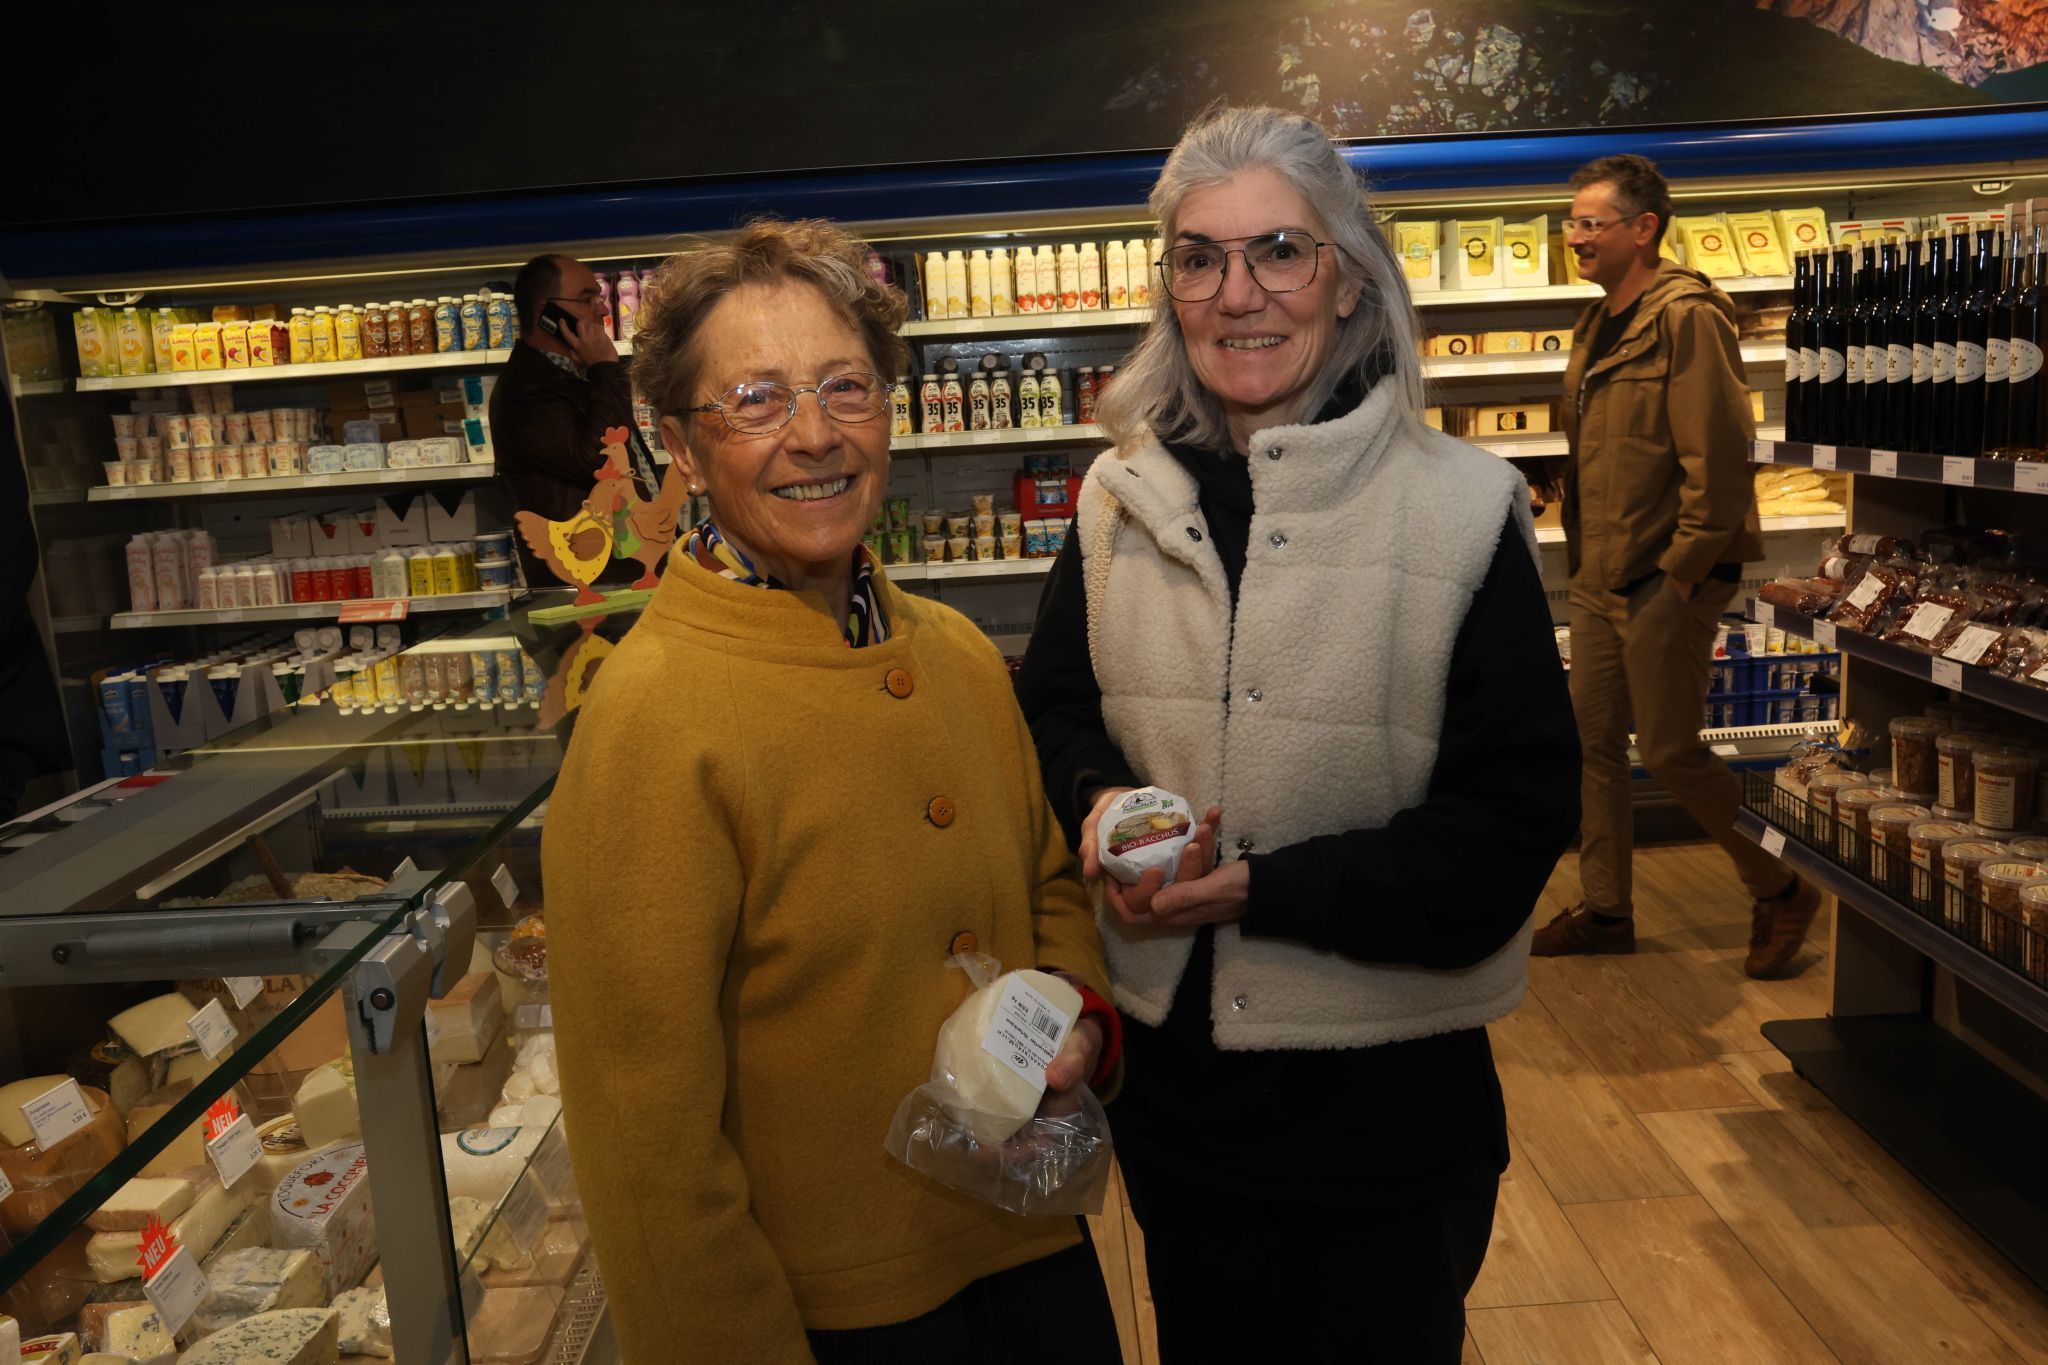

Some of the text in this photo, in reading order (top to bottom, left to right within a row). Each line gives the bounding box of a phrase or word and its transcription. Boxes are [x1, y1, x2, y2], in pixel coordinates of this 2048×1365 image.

[896, 403, 907, 415] 35
[947, 402, 958, 415] 35
[973, 399, 984, 409] 35
[995, 398, 1006, 408] 35
[1022, 397, 1035, 410] 35
[1042, 396, 1055, 409] 35
[928, 403, 939, 416] 35
[1121, 829, 1179, 852] BIO-BACCHUS
[210, 1111, 235, 1138] NEU
[144, 1237, 167, 1268] NEU
